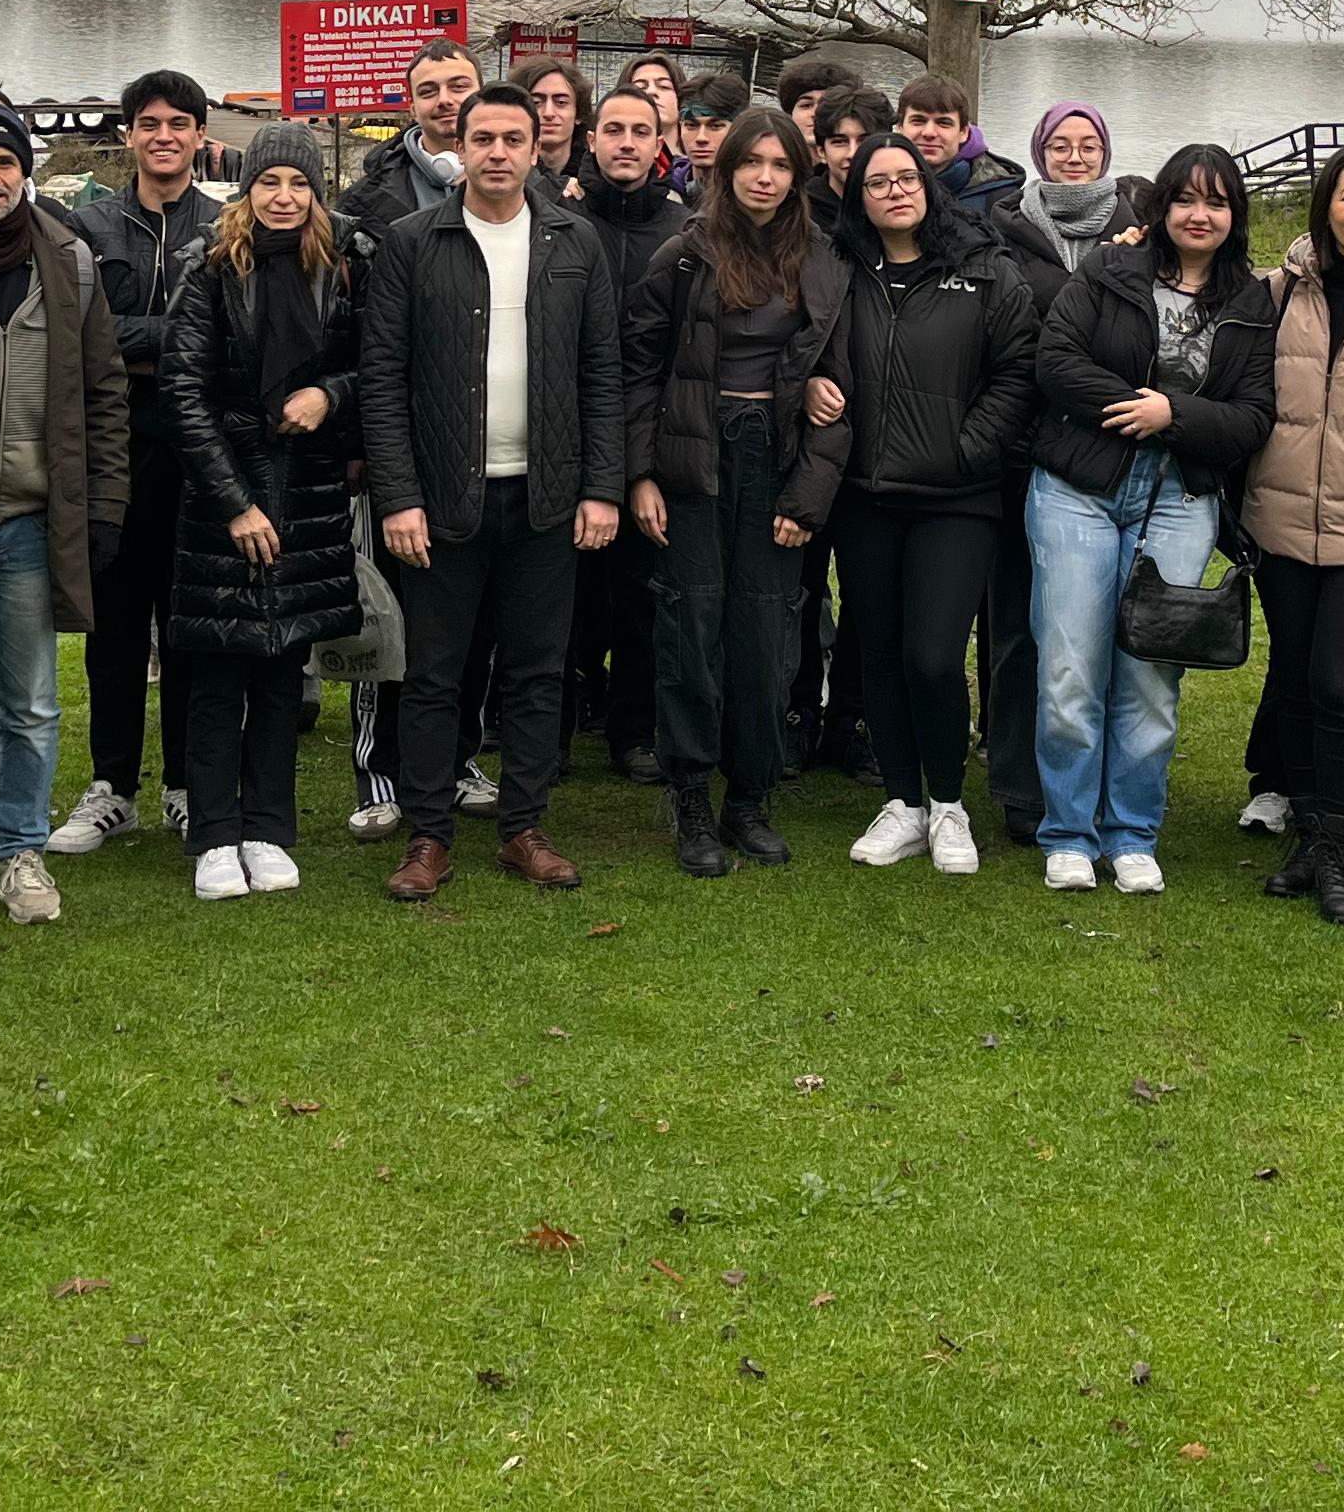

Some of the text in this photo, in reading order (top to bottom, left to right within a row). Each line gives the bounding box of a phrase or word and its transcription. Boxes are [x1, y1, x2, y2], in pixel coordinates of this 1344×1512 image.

[319, 3, 429, 28] ! DİKKAT !
